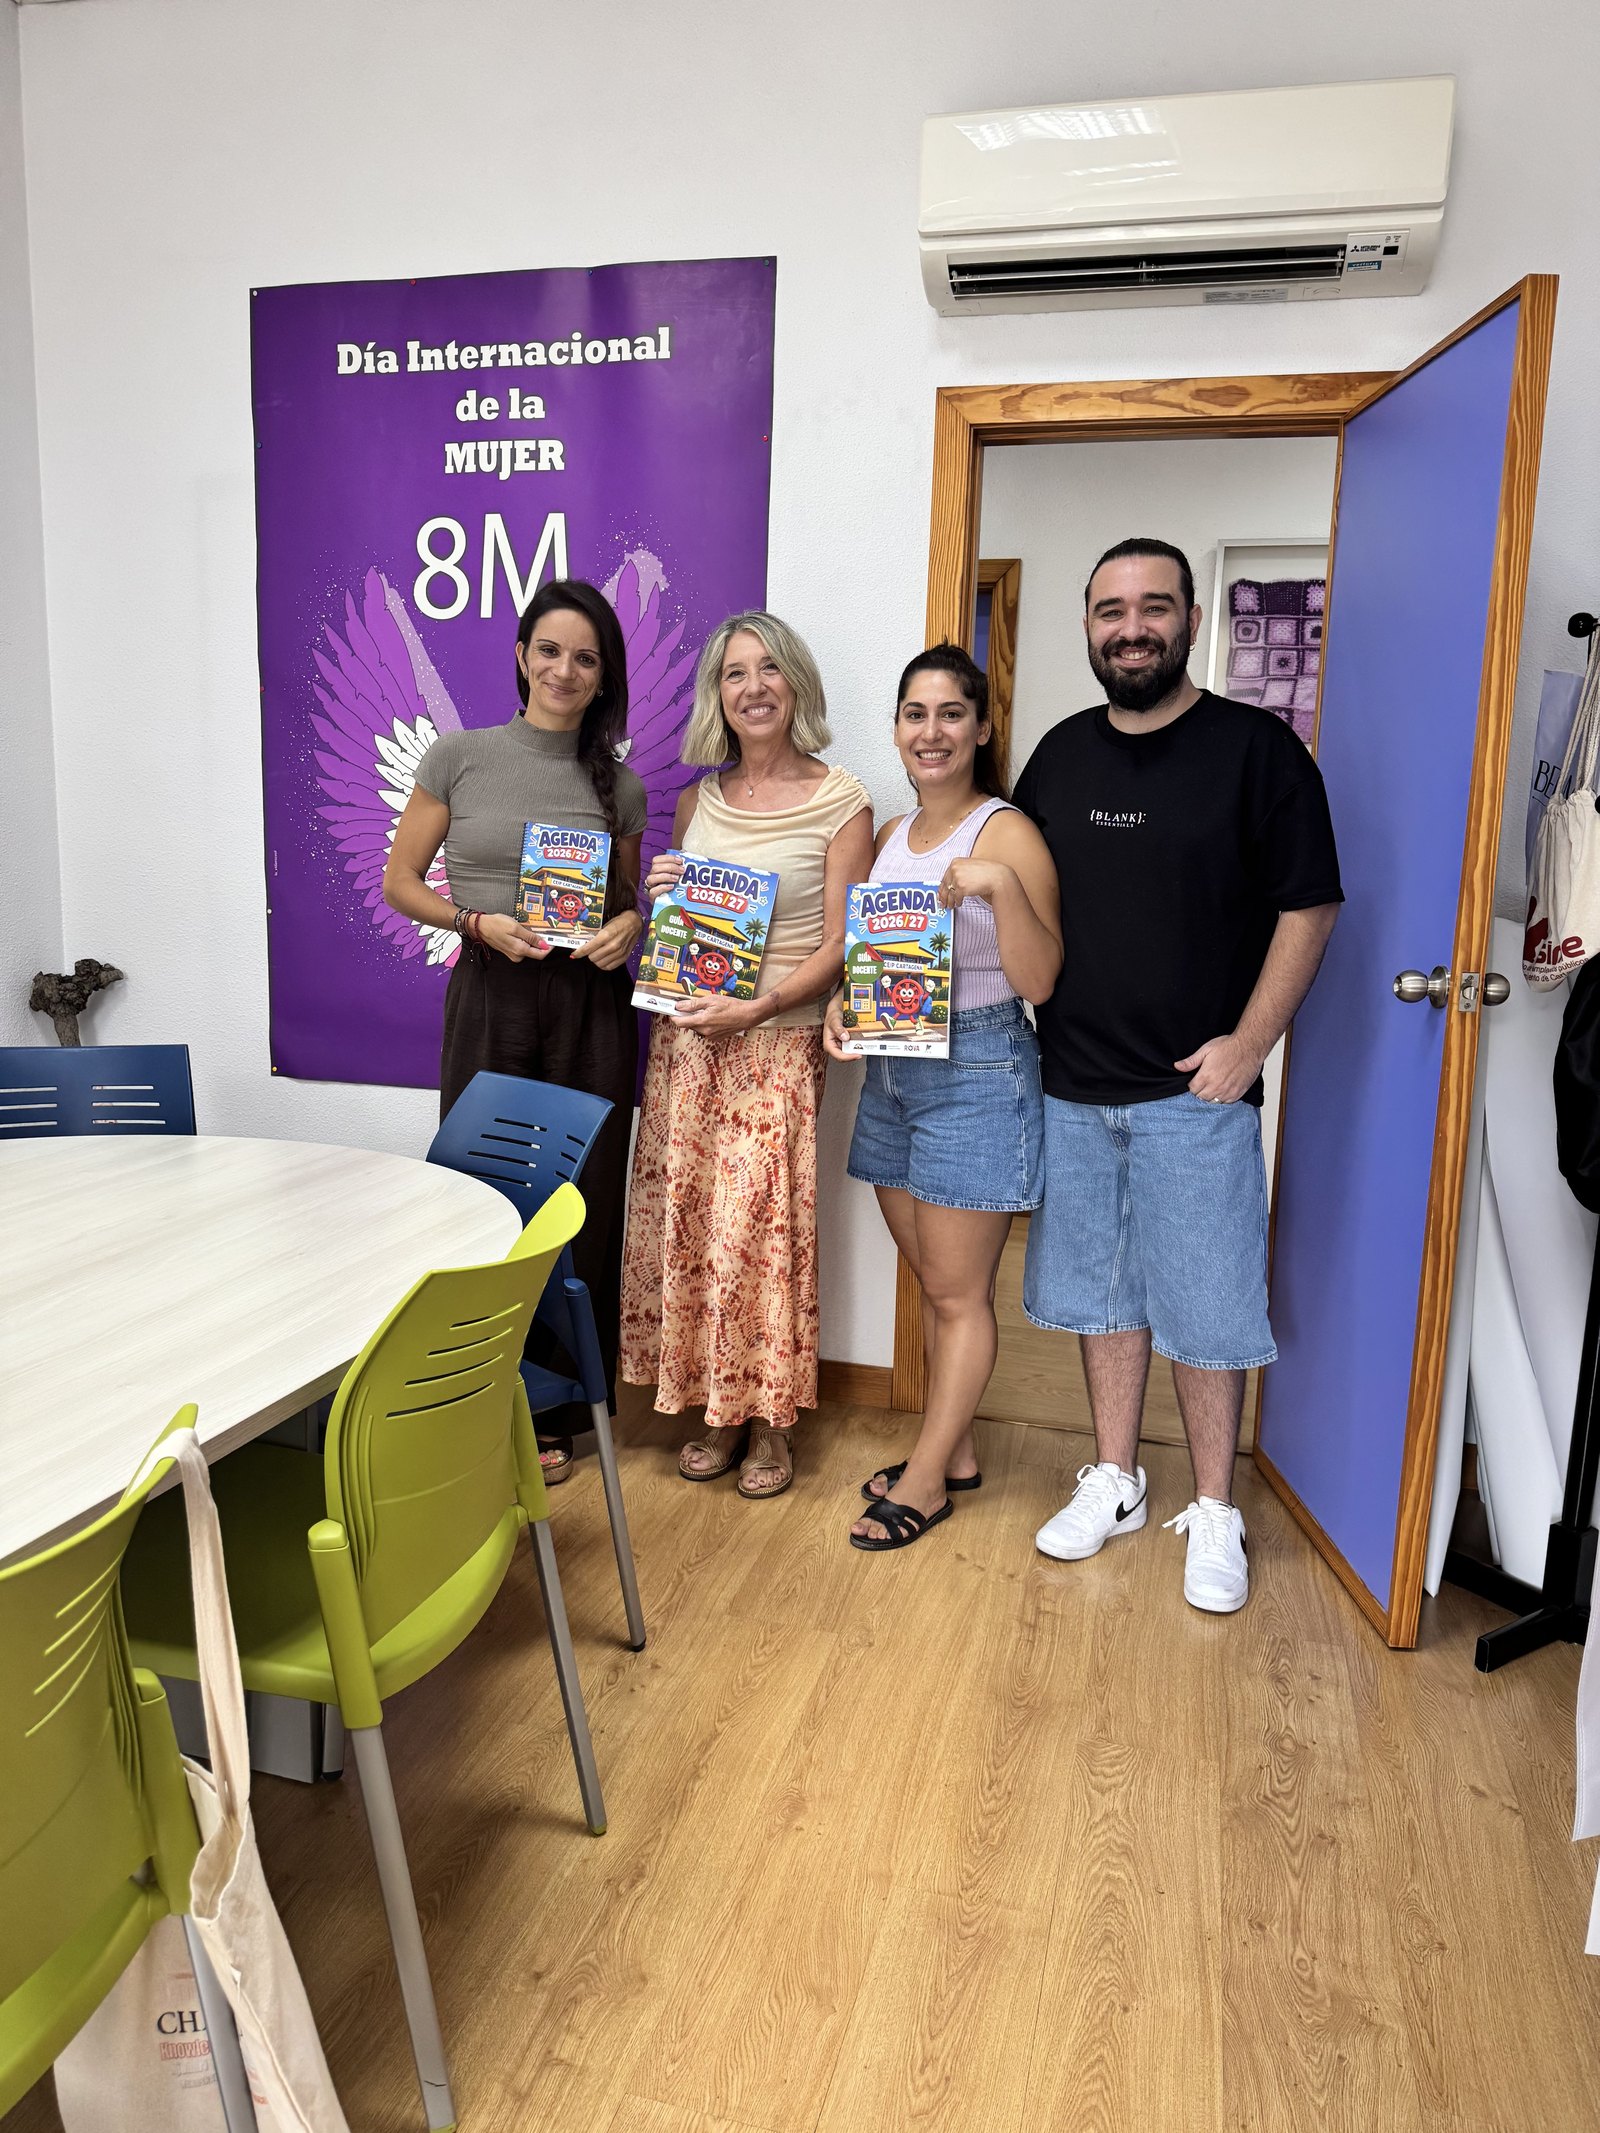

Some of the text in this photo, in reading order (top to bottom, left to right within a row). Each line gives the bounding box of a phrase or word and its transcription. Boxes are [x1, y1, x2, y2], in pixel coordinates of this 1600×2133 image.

[337, 326, 671, 375] Día Internacional
[455, 388, 545, 422] de la
[444, 439, 565, 481] MUJER
[413, 511, 570, 621] 8M
[538, 831, 598, 853] AGENDA
[547, 848, 588, 861] 2026/27
[681, 864, 759, 900] AGENDA
[691, 888, 745, 910] 2026/27
[861, 890, 936, 919] AGENDA
[661, 925, 688, 939] DOCENTE
[872, 914, 925, 930] 2026/27
[706, 935, 734, 949] CARTAGENA
[852, 965, 877, 975] DOCENTE
[895, 963, 923, 971] CARTAGENA
[157, 2009, 207, 2035] CH
